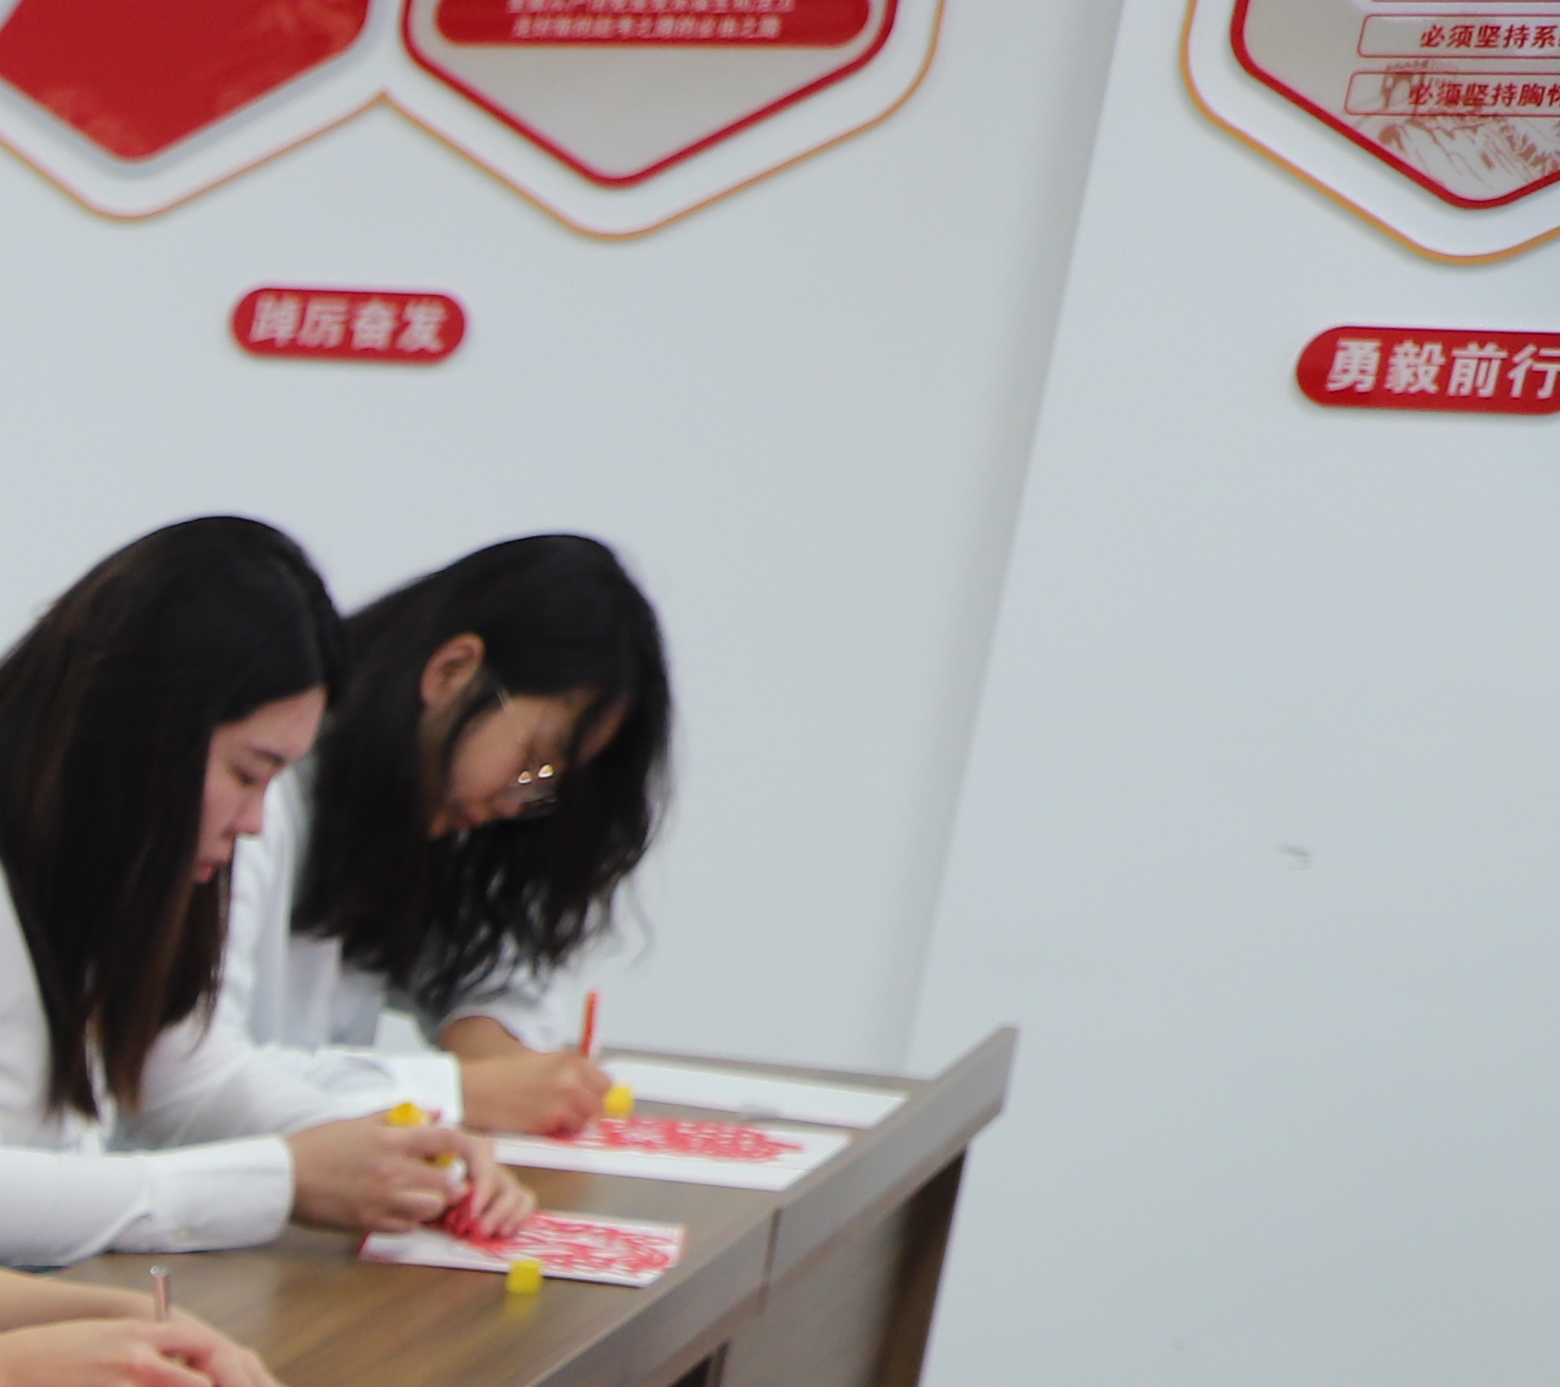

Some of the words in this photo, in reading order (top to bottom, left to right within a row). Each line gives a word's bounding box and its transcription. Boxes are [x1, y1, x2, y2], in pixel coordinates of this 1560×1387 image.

[249, 293, 447, 354] 踔厉奋发
[1326, 338, 1560, 399] 勇毅前行
